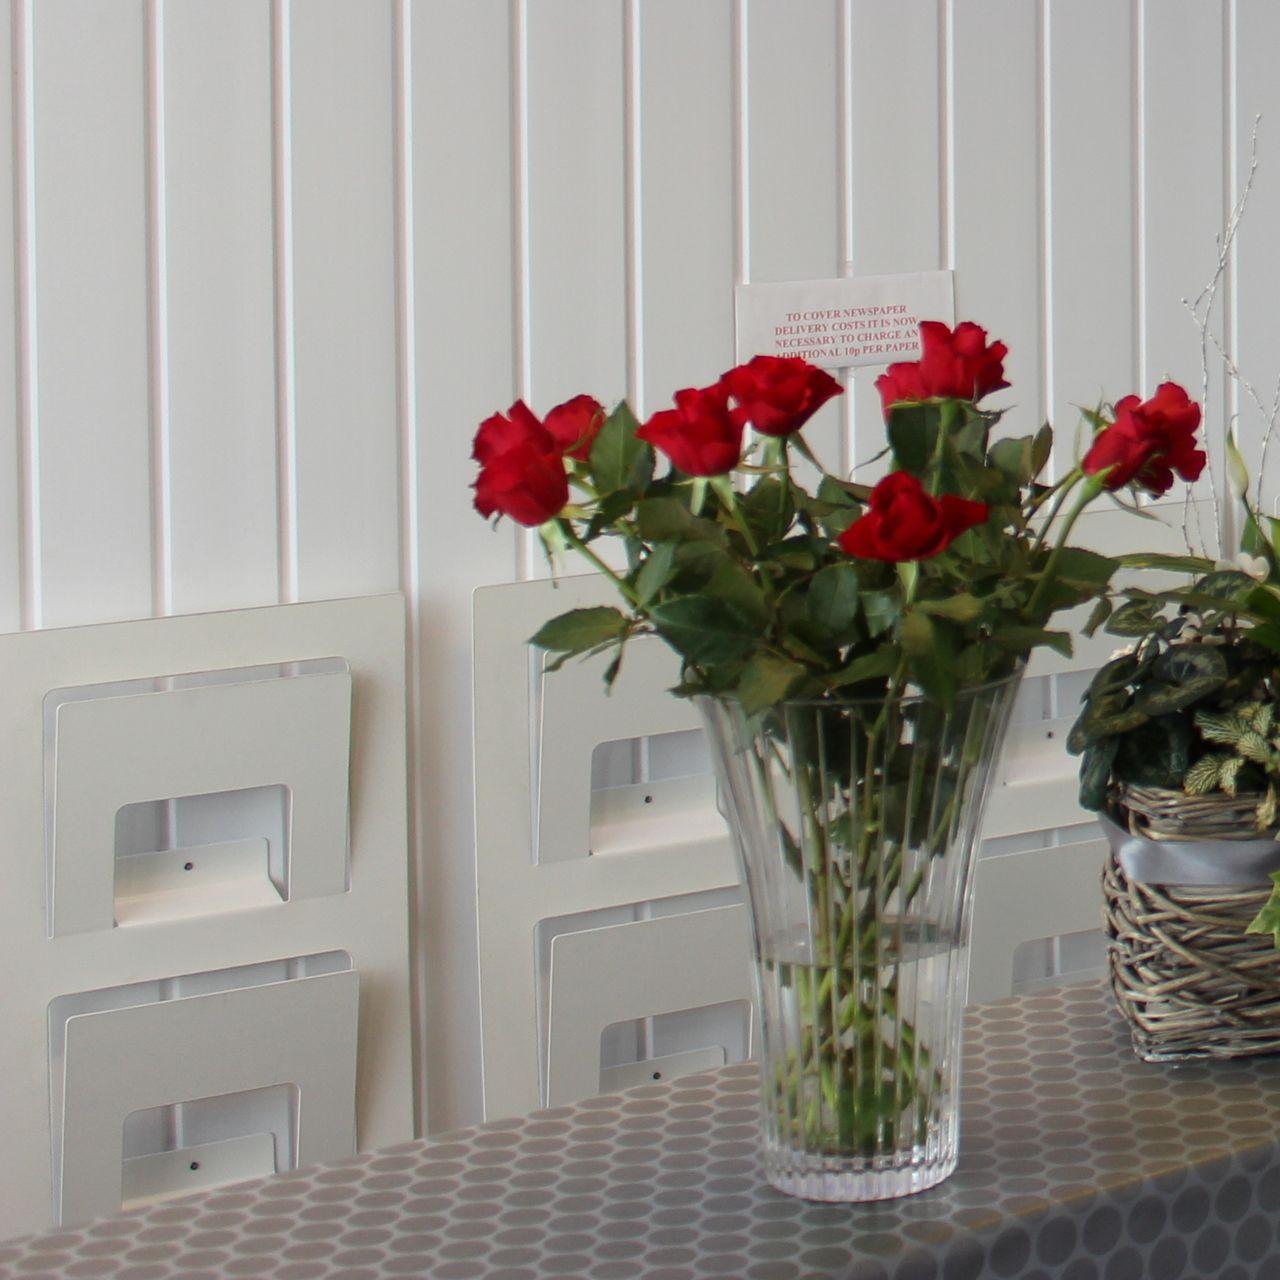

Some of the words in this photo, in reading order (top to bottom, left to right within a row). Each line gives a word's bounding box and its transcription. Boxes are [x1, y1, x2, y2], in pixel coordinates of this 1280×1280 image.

[786, 312, 801, 322] TO
[803, 310, 841, 321] COVER
[843, 305, 907, 318] NEWSPAPER
[775, 323, 828, 336] DELIVERY
[832, 320, 865, 332] COSTS
[867, 319, 878, 329] IT
[880, 318, 890, 328] IS
[893, 316, 919, 327] NOW
[775, 334, 838, 348] NECESSARY
[840, 333, 855, 344] TO
[857, 330, 901, 342] CHARGE
[904, 328, 918, 339] AN
[844, 346, 861, 358] 10p
[862, 344, 883, 355] PER
[885, 341, 919, 353] PAPER
